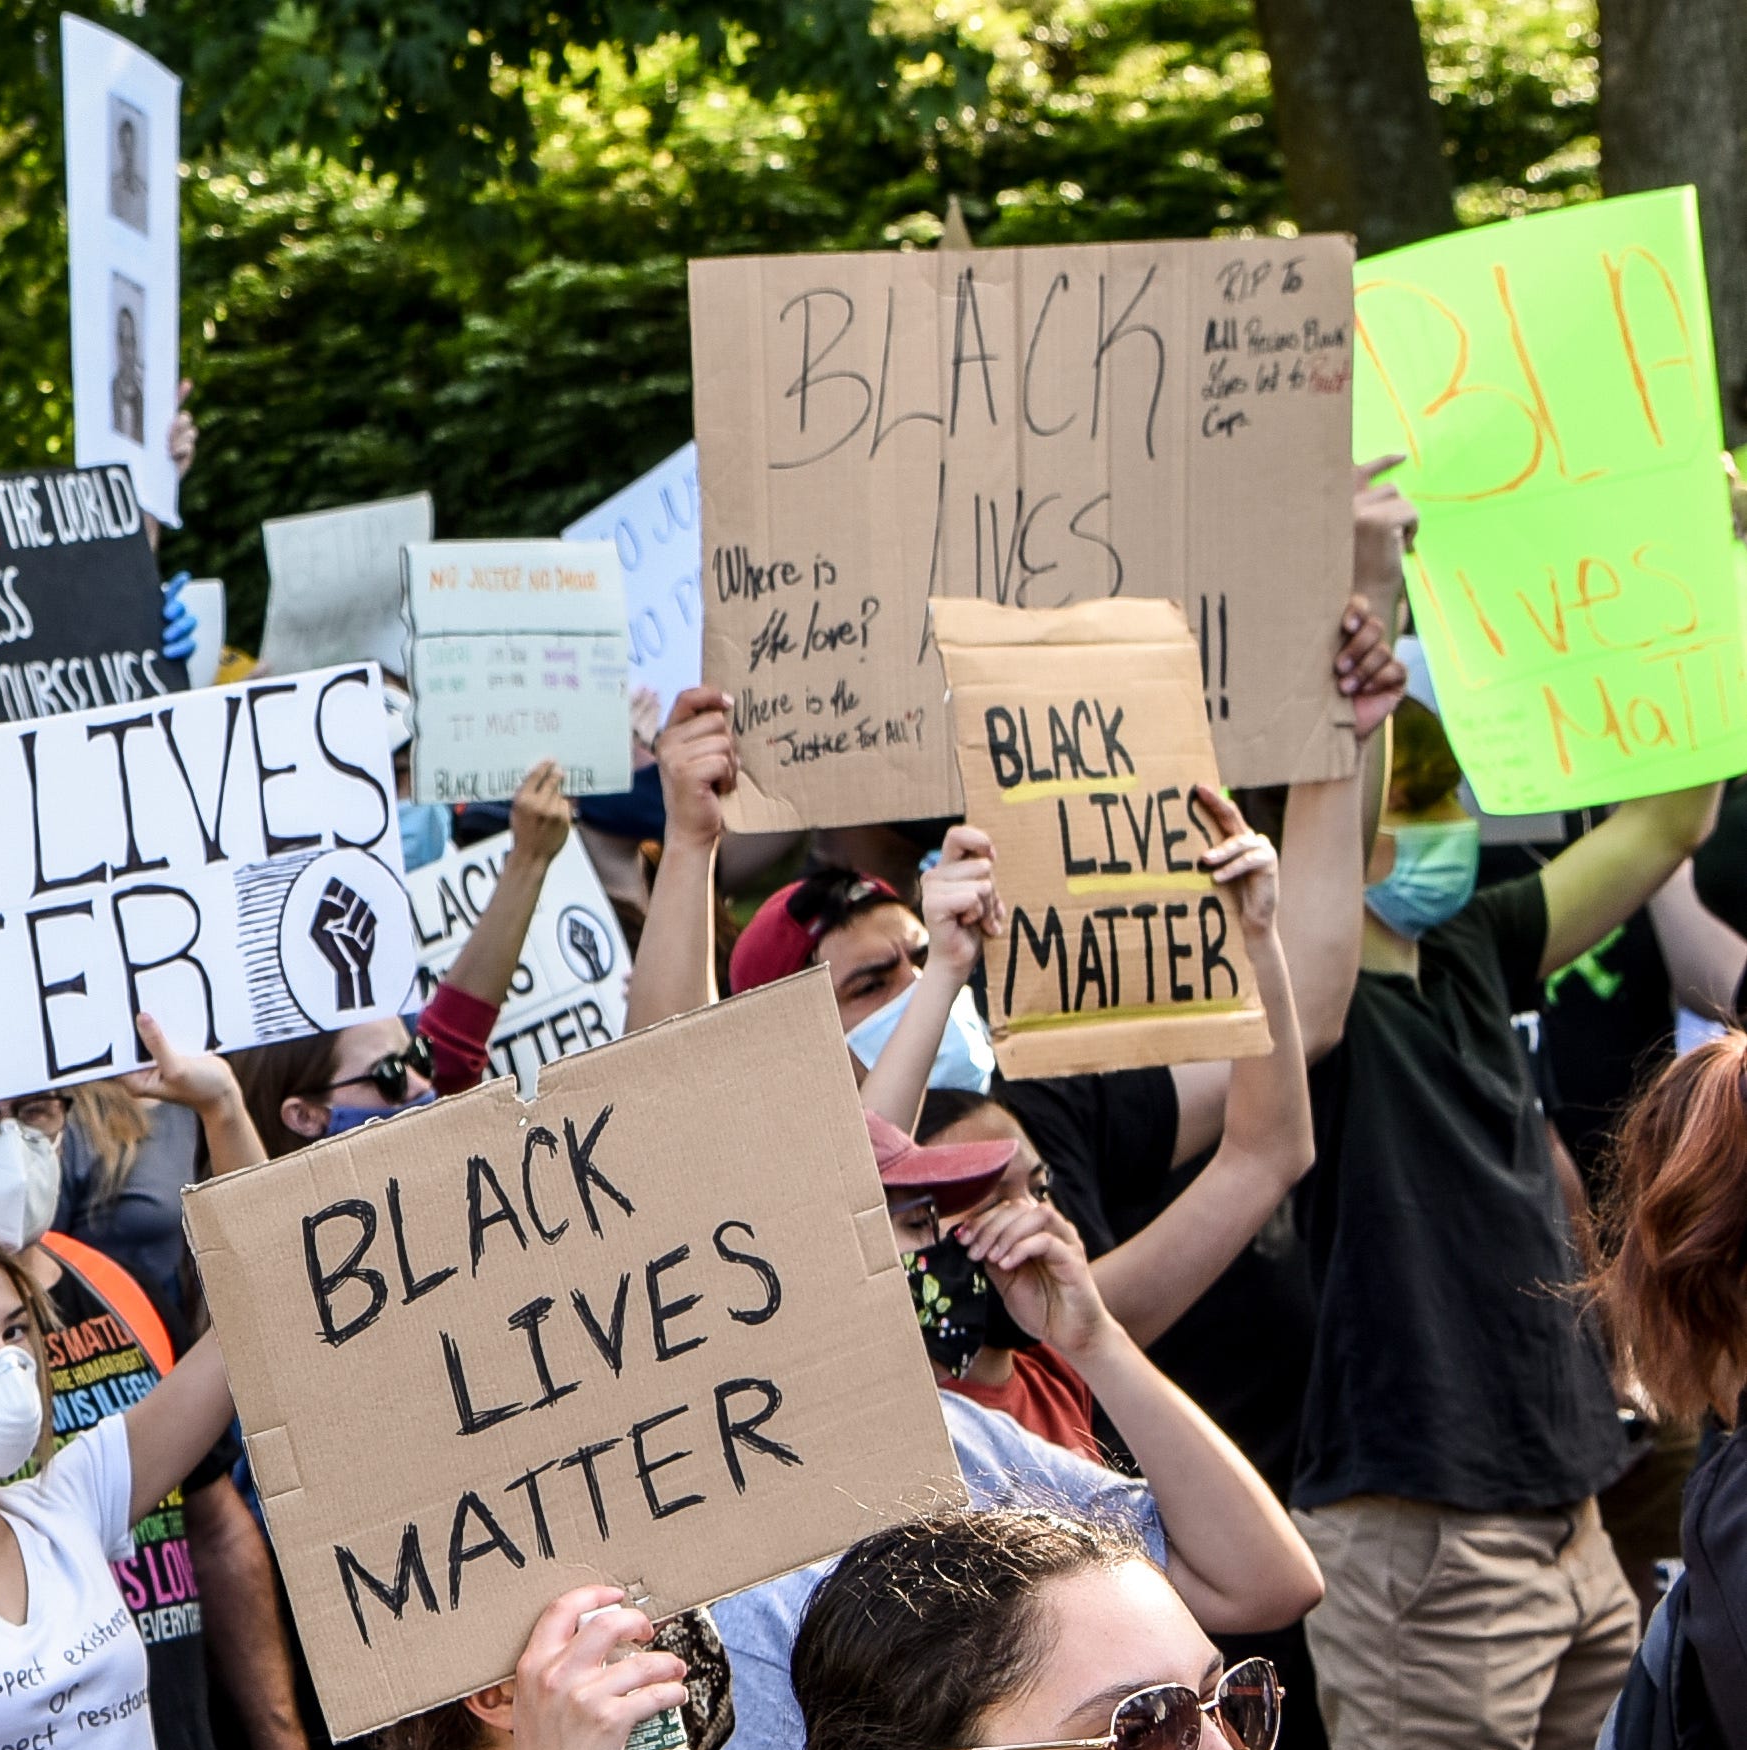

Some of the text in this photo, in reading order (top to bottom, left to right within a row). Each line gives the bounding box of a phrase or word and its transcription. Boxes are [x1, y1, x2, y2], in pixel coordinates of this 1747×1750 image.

[770, 264, 1167, 470] BLACK
[1355, 245, 1701, 503] BLA
[44, 466, 142, 547] WORLD
[925, 458, 1125, 606] LIVES
[712, 545, 837, 604] Where is
[802, 595, 880, 664] love?
[20, 668, 391, 900] LIVES
[985, 698, 1138, 789] BLACK
[1057, 783, 1215, 876] LIVES
[1004, 894, 1241, 1016] MATTER
[301, 1102, 636, 1349] BLACK
[439, 1218, 783, 1437] LIVES
[332, 1376, 804, 1649] MATTER
[49, 1681, 82, 1714] or
